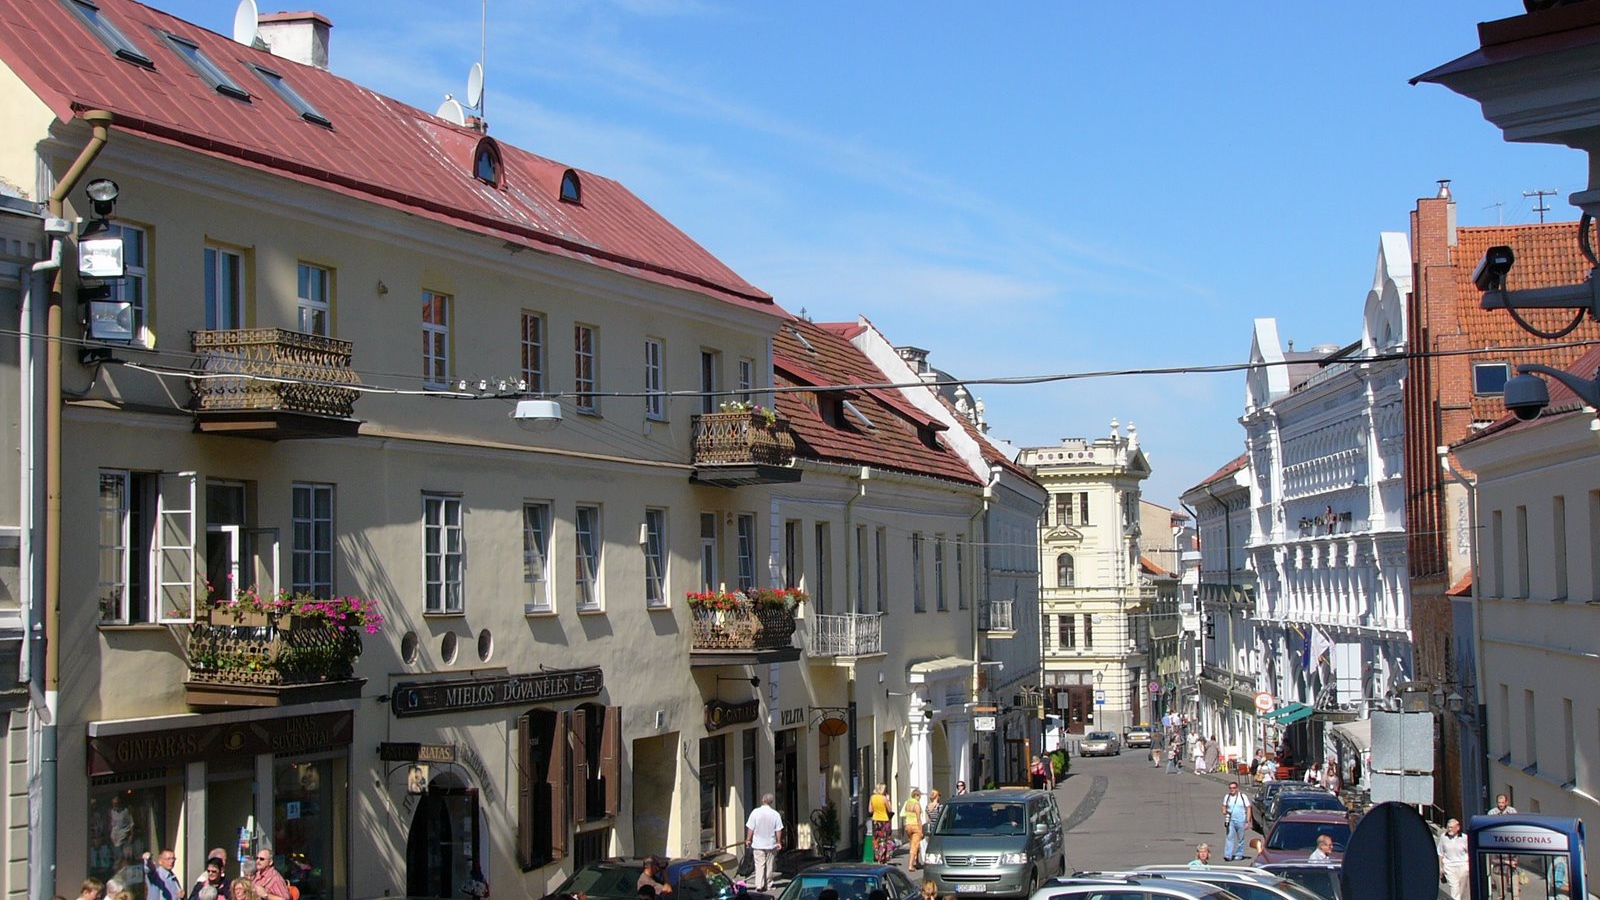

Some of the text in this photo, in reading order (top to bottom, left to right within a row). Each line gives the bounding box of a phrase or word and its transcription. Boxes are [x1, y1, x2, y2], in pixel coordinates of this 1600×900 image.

[446, 685, 494, 706] MIELOS
[503, 677, 569, 699] DOVANĖLĖS
[781, 708, 803, 725] VELITA
[117, 734, 197, 762] GINTARAS
[1494, 836, 1552, 844] TAKSOFONAS
